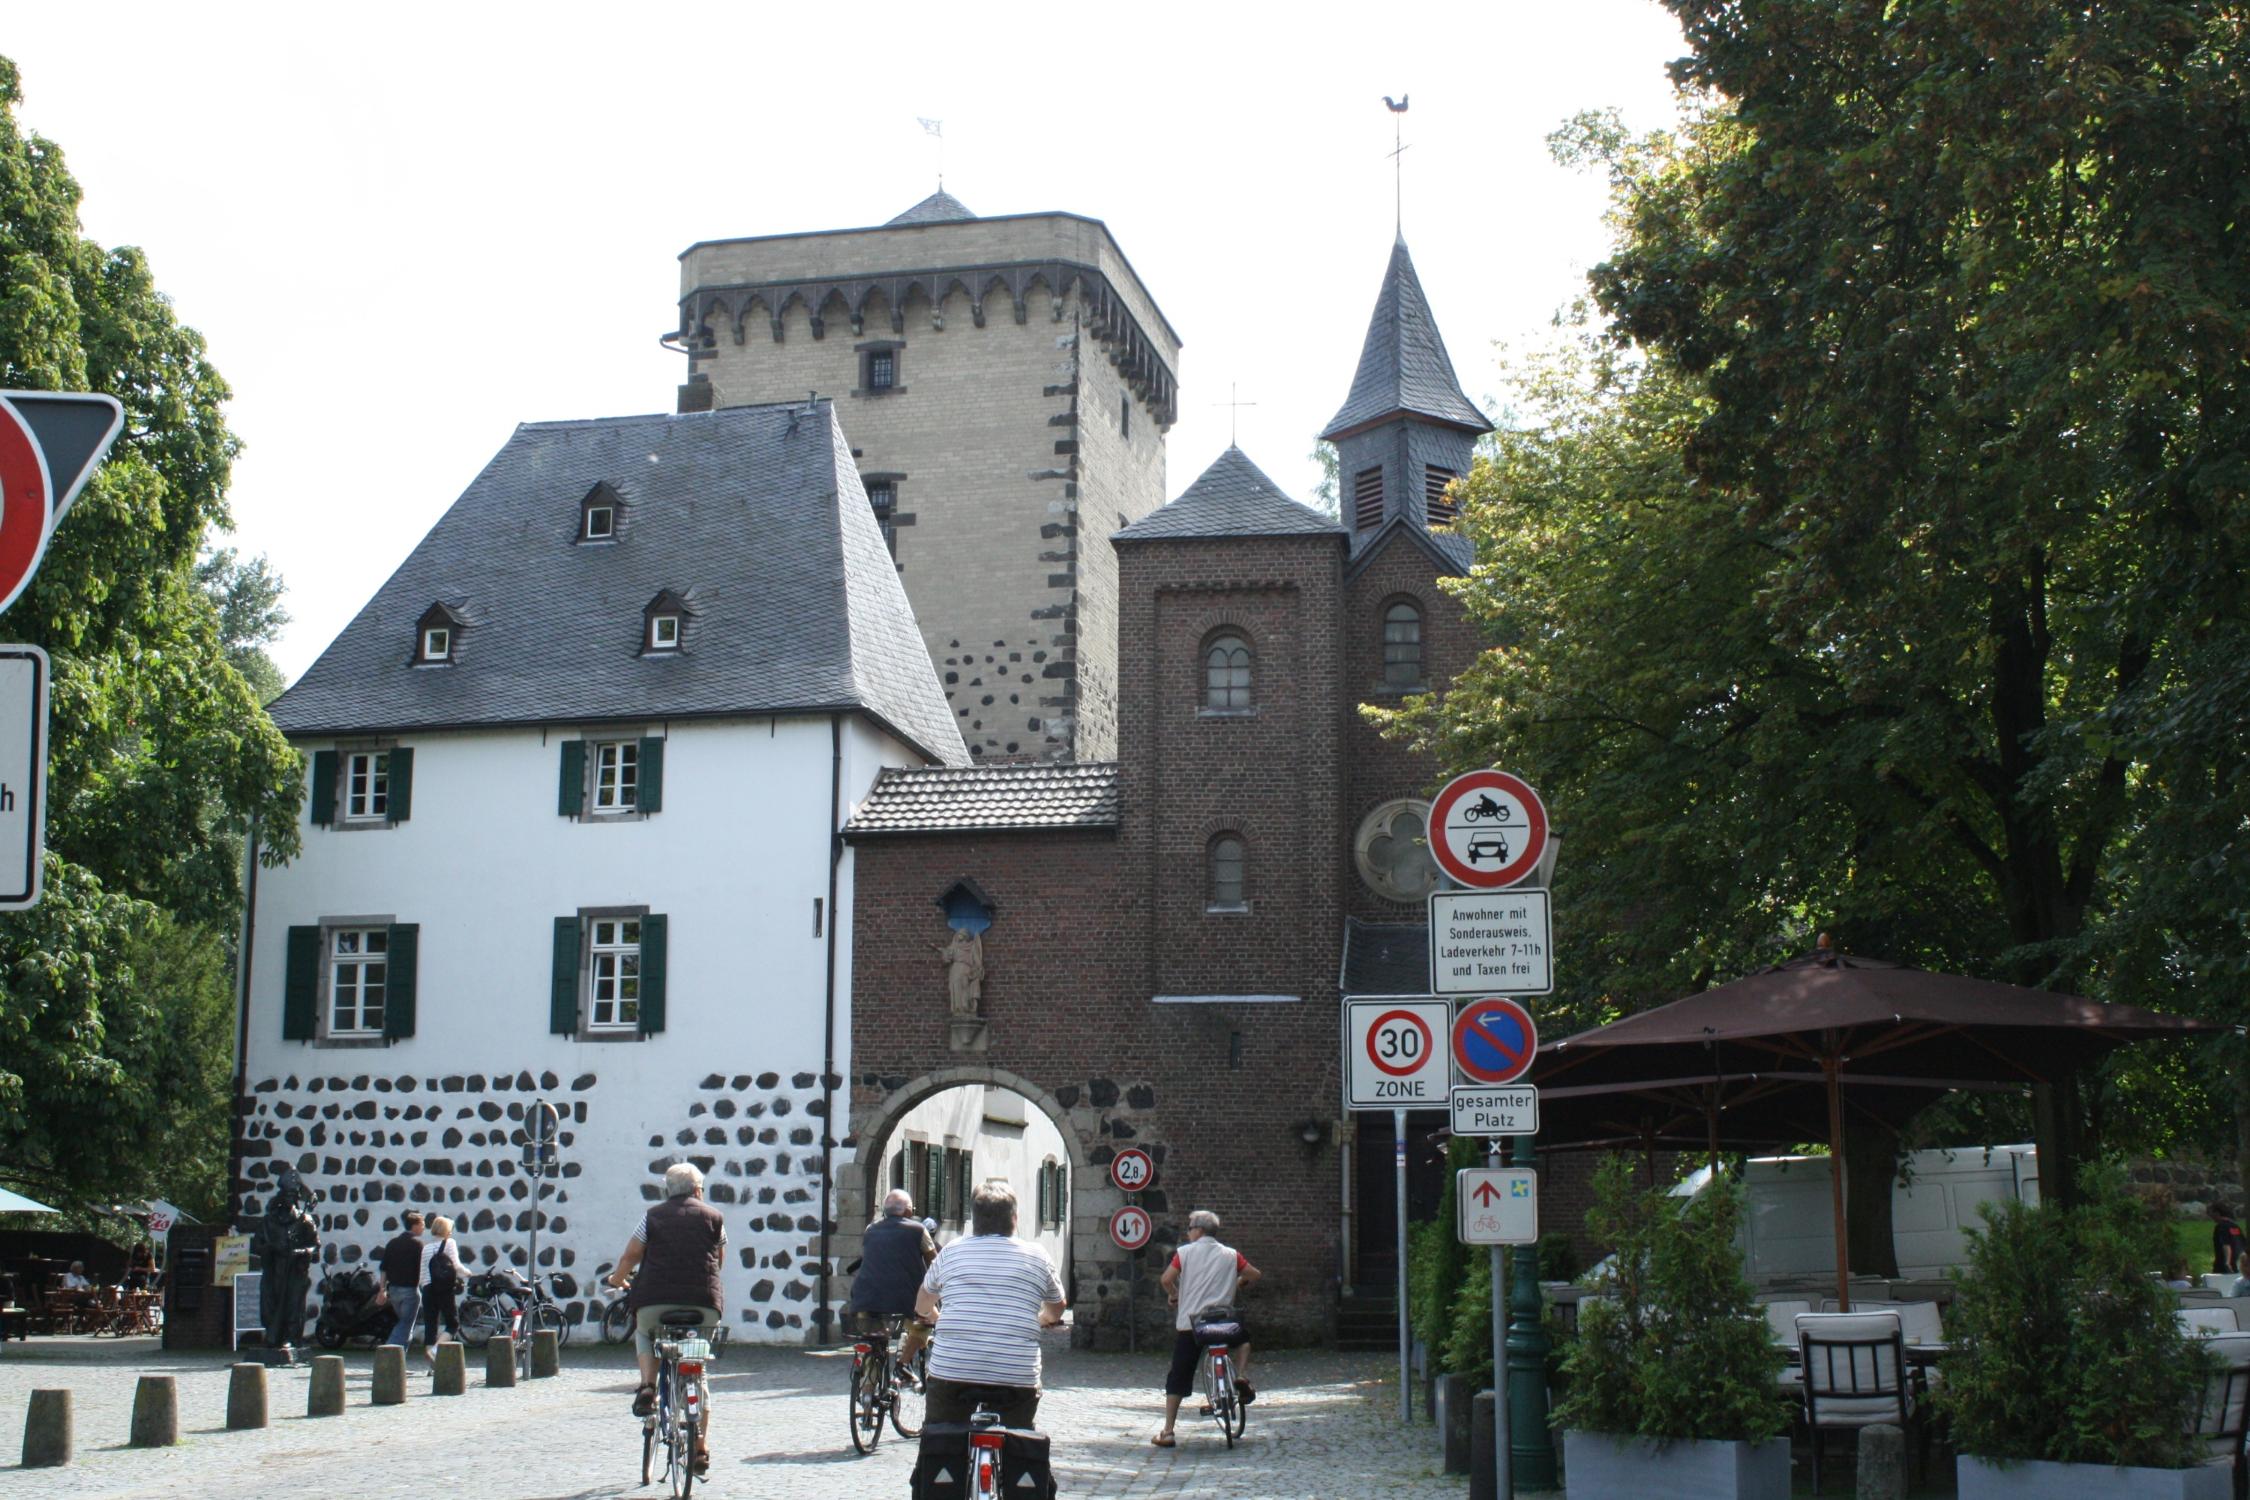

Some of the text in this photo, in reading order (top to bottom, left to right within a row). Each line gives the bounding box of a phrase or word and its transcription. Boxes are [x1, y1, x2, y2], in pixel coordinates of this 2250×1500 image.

[1452, 906, 1527, 921] Anwohner mit
[1440, 943, 1541, 959] Ladeverkehr 7-11h
[1452, 961, 1530, 977] und Taxen frei
[1380, 1028, 1419, 1058] 30
[1375, 1080, 1426, 1097] ZONE
[1456, 1094, 1532, 1112] gesamter
[1474, 1112, 1515, 1127] Platz
